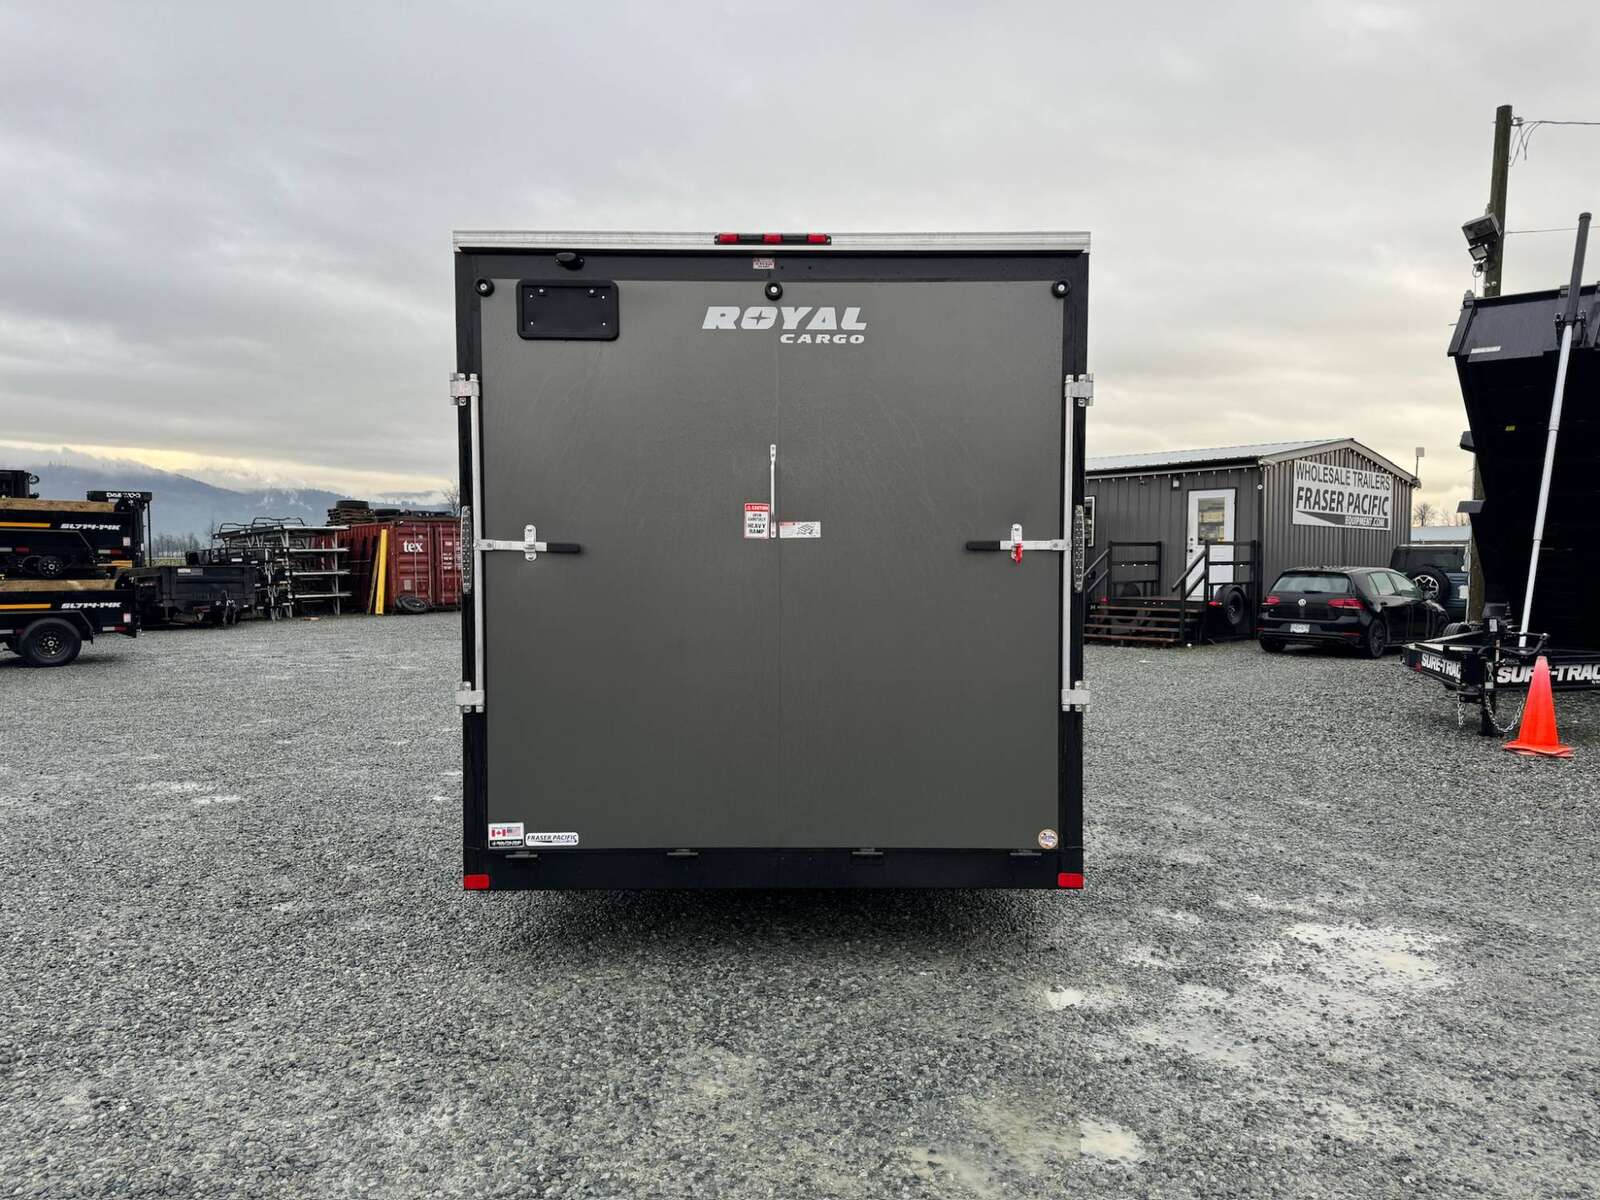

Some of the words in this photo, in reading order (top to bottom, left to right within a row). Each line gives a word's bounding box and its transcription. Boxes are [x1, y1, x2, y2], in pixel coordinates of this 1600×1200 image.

[702, 306, 867, 330] ROYAL
[780, 333, 865, 344] CARGO
[1296, 462, 1350, 486] WHOLESALE
[1353, 470, 1391, 491] TRAILERS
[1296, 486, 1345, 512] FRASER
[1346, 491, 1390, 517] PACIFIC
[403, 540, 423, 552] tex
